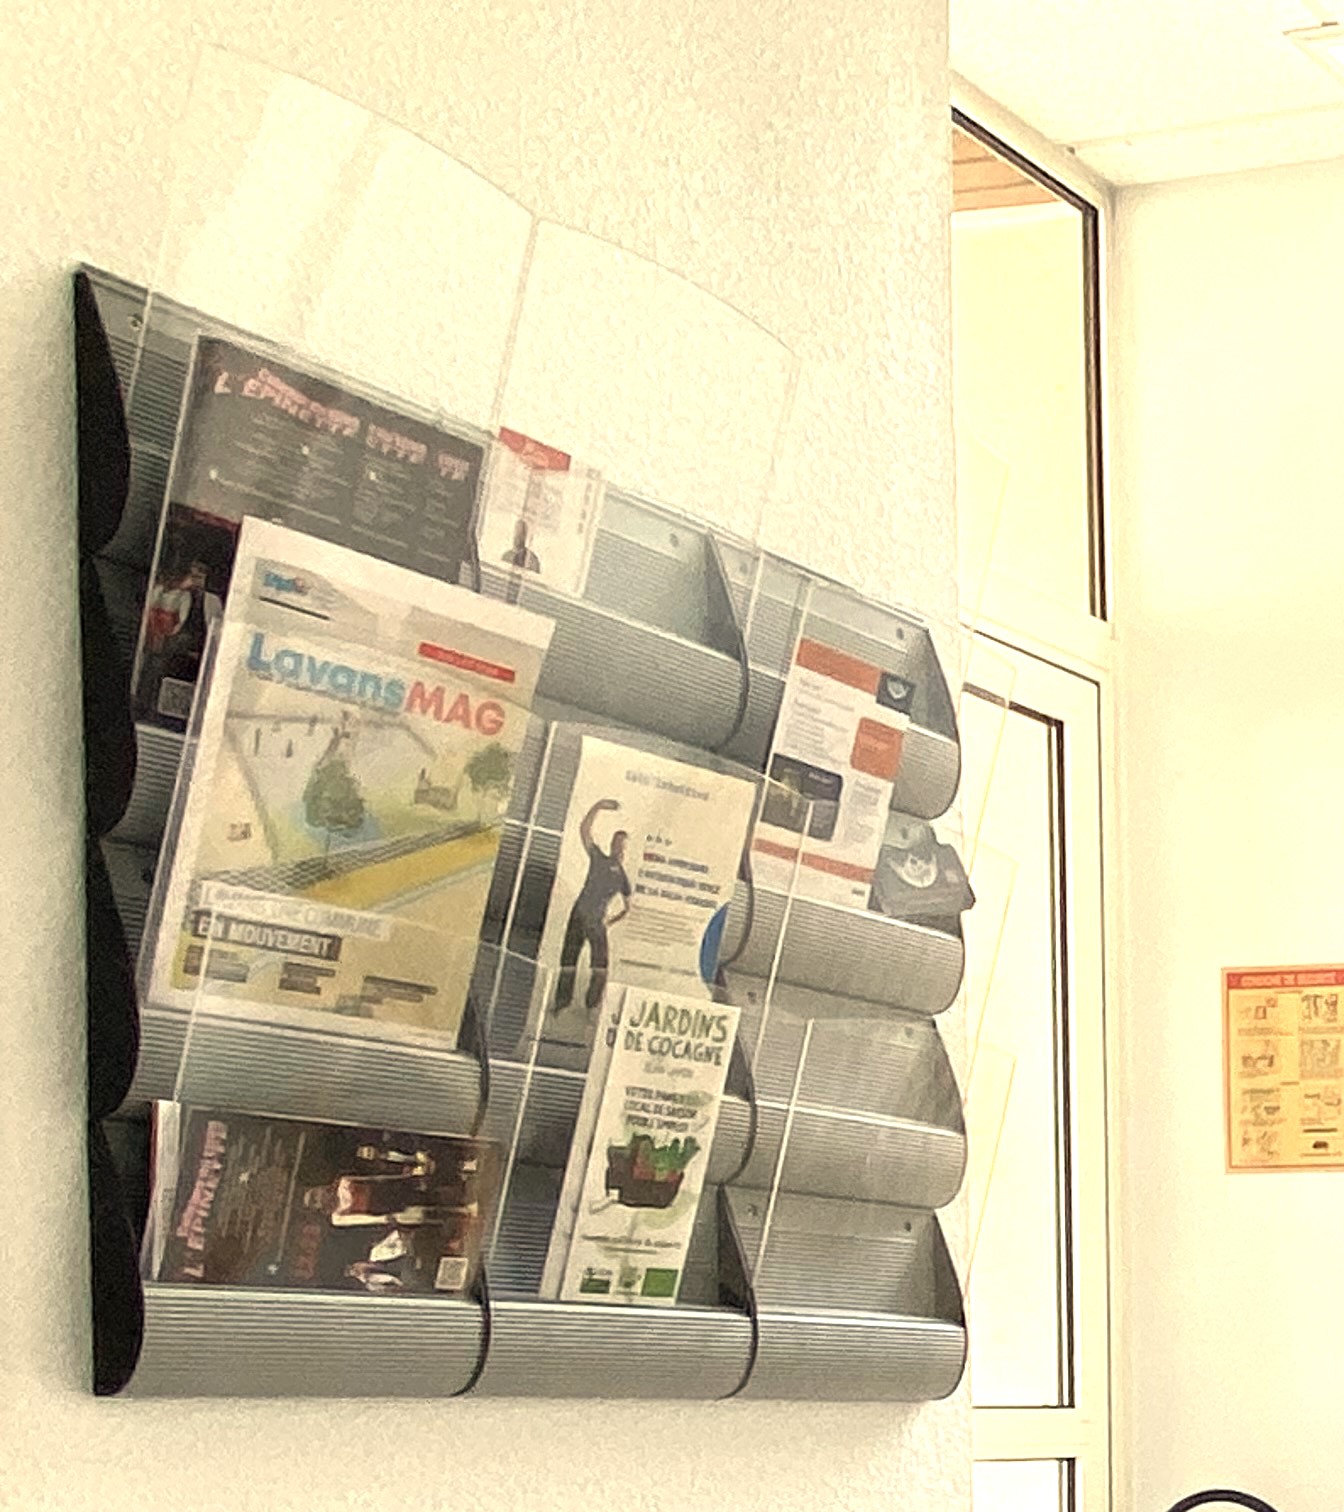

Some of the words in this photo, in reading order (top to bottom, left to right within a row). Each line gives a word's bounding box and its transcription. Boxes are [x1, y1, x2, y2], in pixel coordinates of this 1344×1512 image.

[227, 918, 337, 958] MOUVEMENT
[629, 1002, 728, 1043] JARDINS
[623, 1029, 645, 1052] DE
[646, 1035, 723, 1067] COCAGNE
